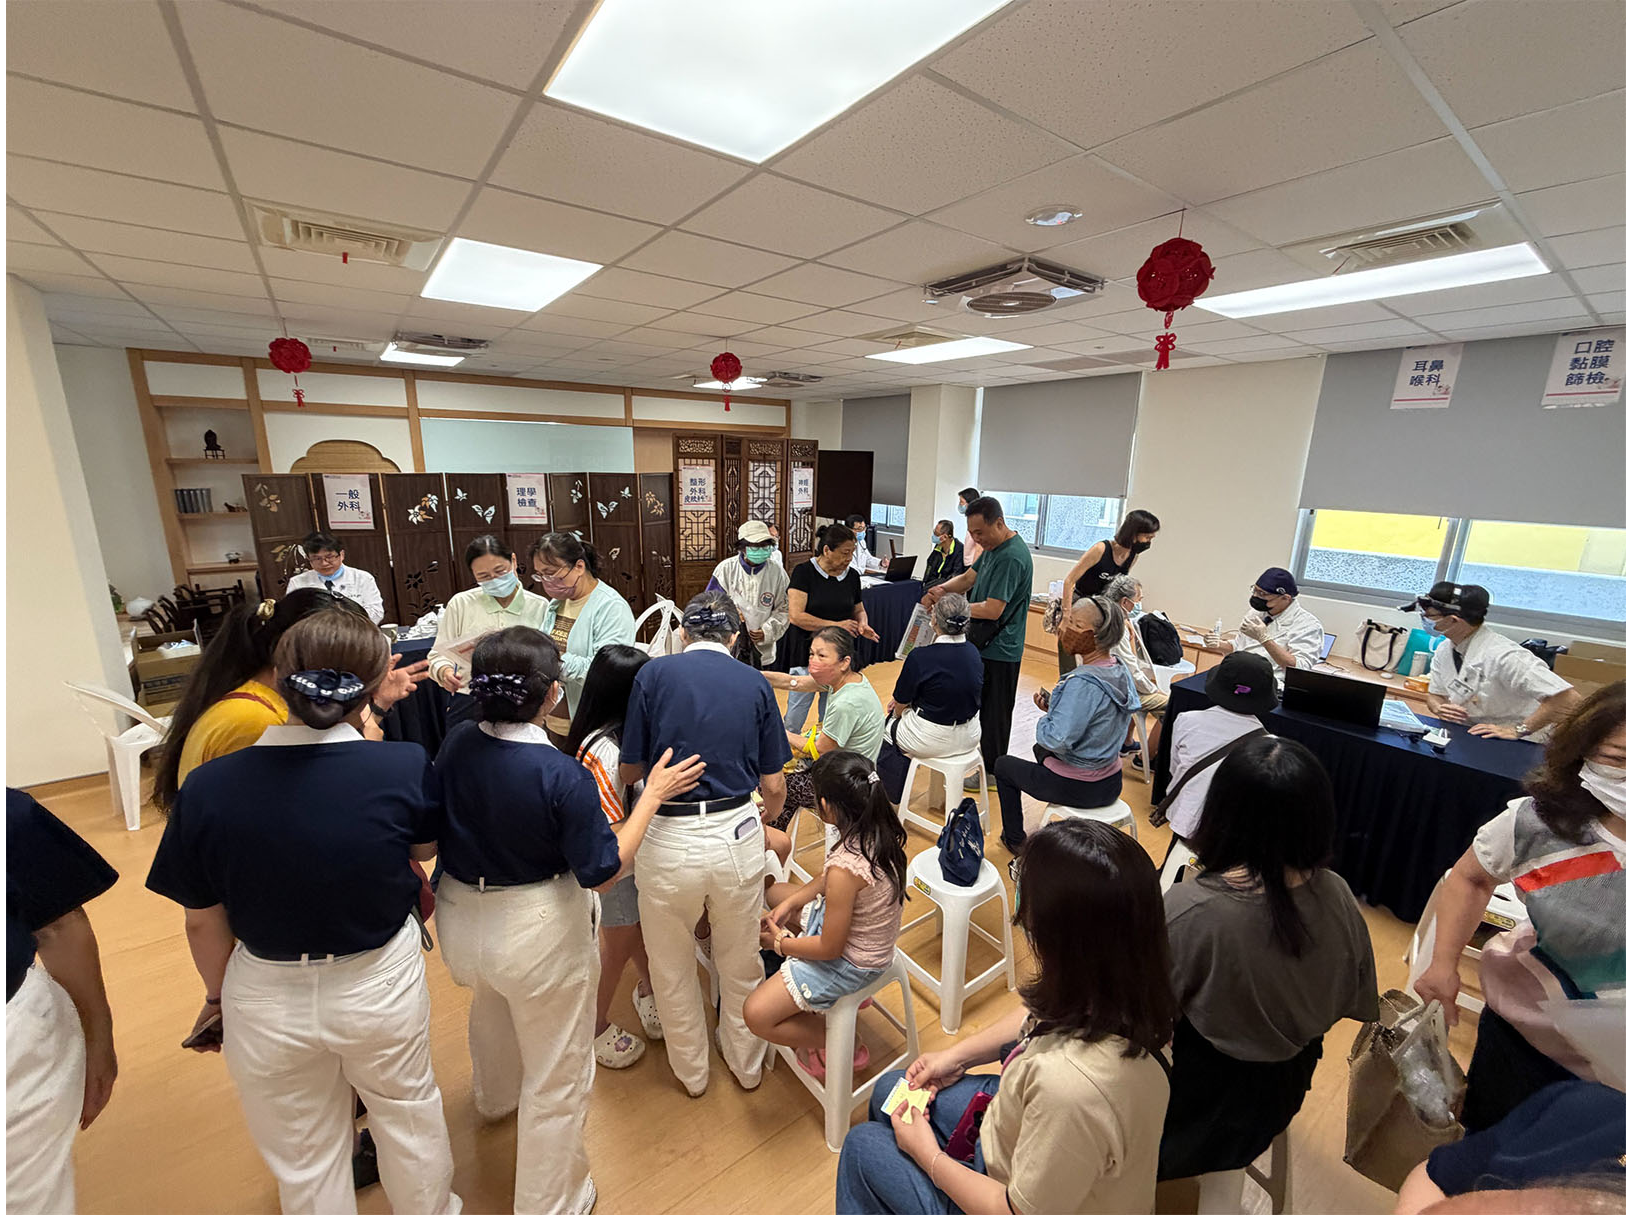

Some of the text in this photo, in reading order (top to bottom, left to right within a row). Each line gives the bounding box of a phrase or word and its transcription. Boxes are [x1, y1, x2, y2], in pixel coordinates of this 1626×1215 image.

[1574, 339, 1615, 355] 口腔
[1412, 359, 1444, 373] 耳鼻
[1568, 355, 1611, 371] 黏膜
[1409, 373, 1441, 387] 喉科
[1565, 371, 1606, 387] 篩檢
[689, 477, 707, 487] 整形
[335, 488, 360, 500] 一般
[516, 487, 537, 498] 理學
[689, 487, 707, 496] 外科
[337, 500, 361, 512] 外科
[517, 497, 538, 508] 檢查
